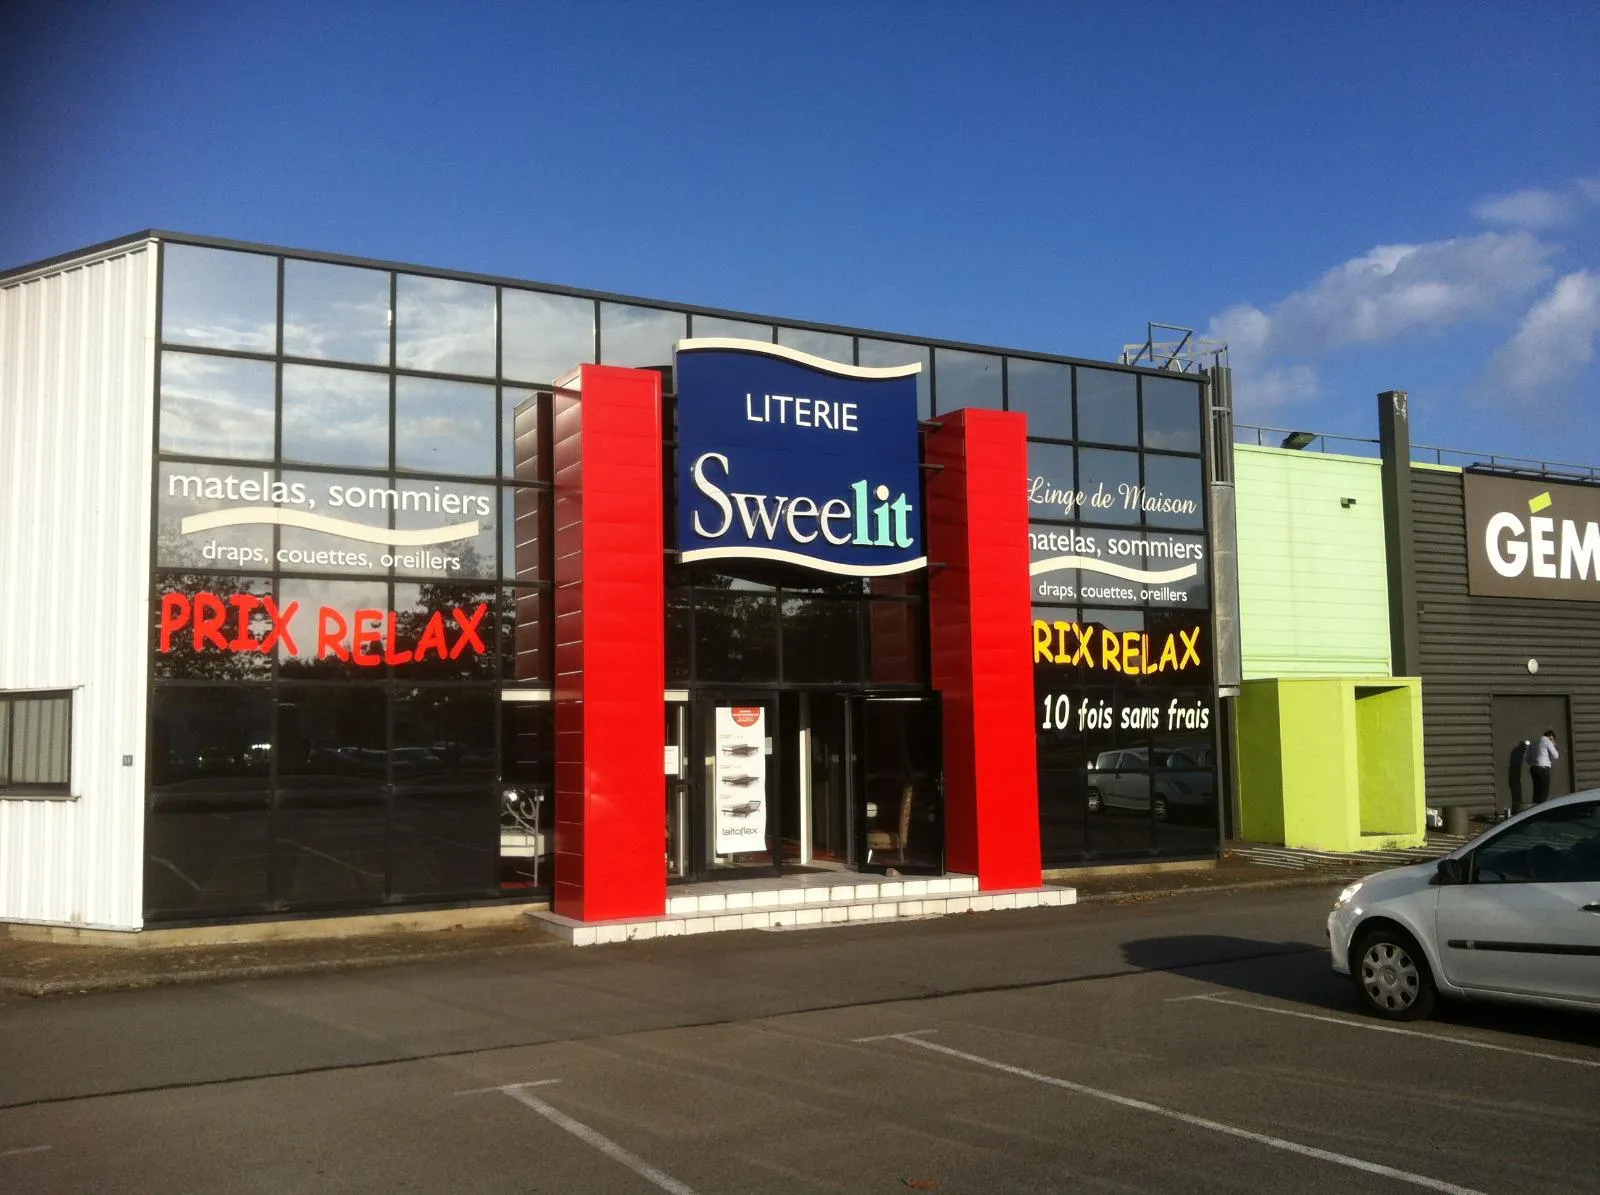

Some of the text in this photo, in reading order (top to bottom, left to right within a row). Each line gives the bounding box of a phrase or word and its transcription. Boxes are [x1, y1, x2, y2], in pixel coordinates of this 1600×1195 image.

[746, 393, 858, 432] LITERIE
[168, 472, 490, 516] matelas, sommiers
[692, 452, 914, 549] Sweelit
[1027, 476, 1197, 515] Linge de Maison
[202, 540, 461, 570] draps, couettes, oreillers
[1108, 537, 1203, 560] sommiers
[1039, 581, 1188, 602] draps, couettes, oreillers
[160, 591, 488, 666] PRIX RELAX
[1102, 626, 1201, 675] RELAX
[1042, 693, 1210, 731] 10 fois sans frais
